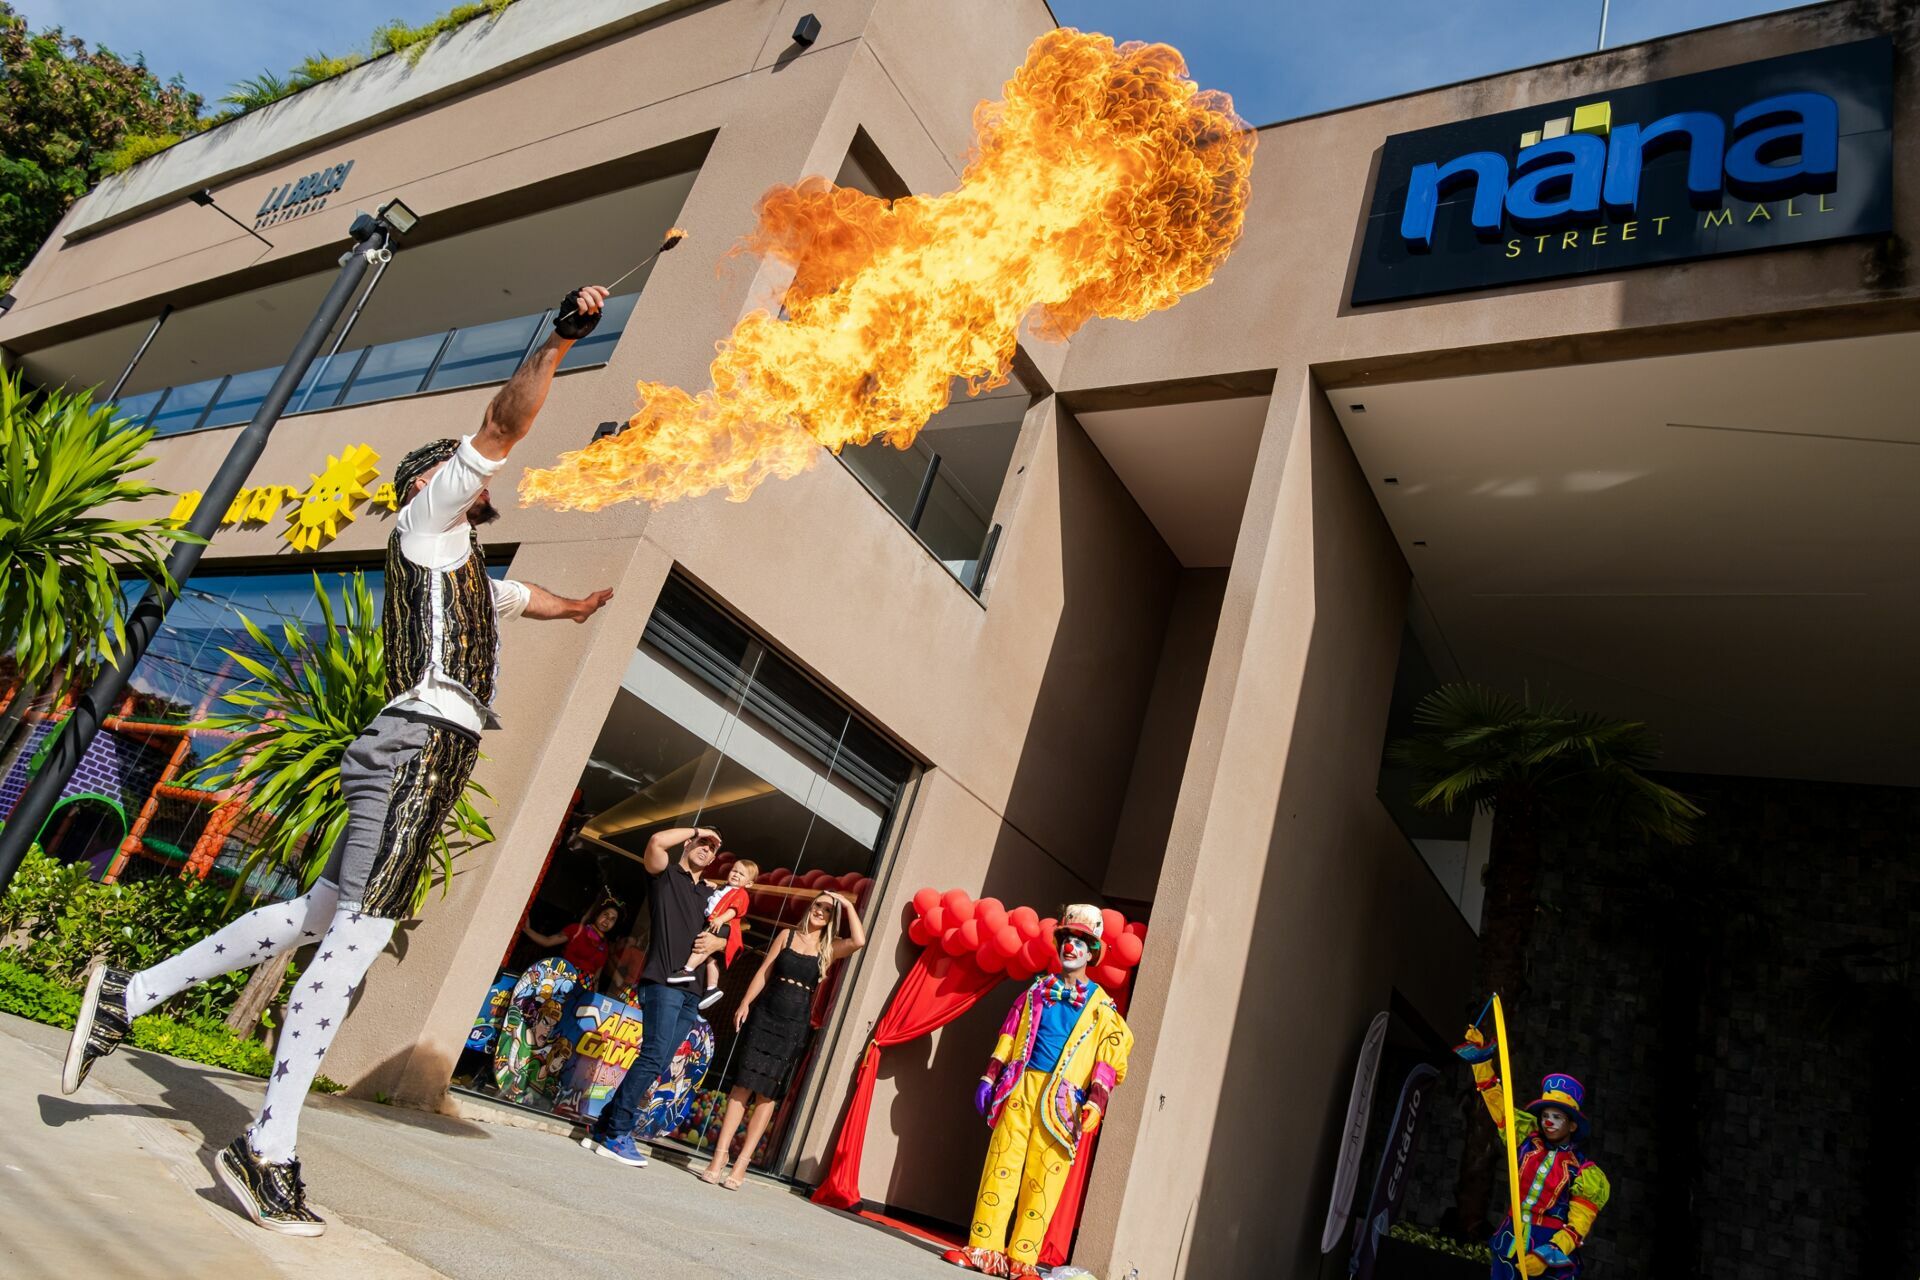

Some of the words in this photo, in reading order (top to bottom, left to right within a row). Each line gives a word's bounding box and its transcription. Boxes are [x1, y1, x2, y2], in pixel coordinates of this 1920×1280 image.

[256, 183, 291, 218] LA
[282, 160, 355, 209] BRASA
[1505, 216, 1671, 258] STREET
[1703, 194, 1835, 230] MALL
[576, 1031, 641, 1070] GAM
[597, 1014, 643, 1044] AIR
[1387, 1089, 1421, 1202] Estácio
